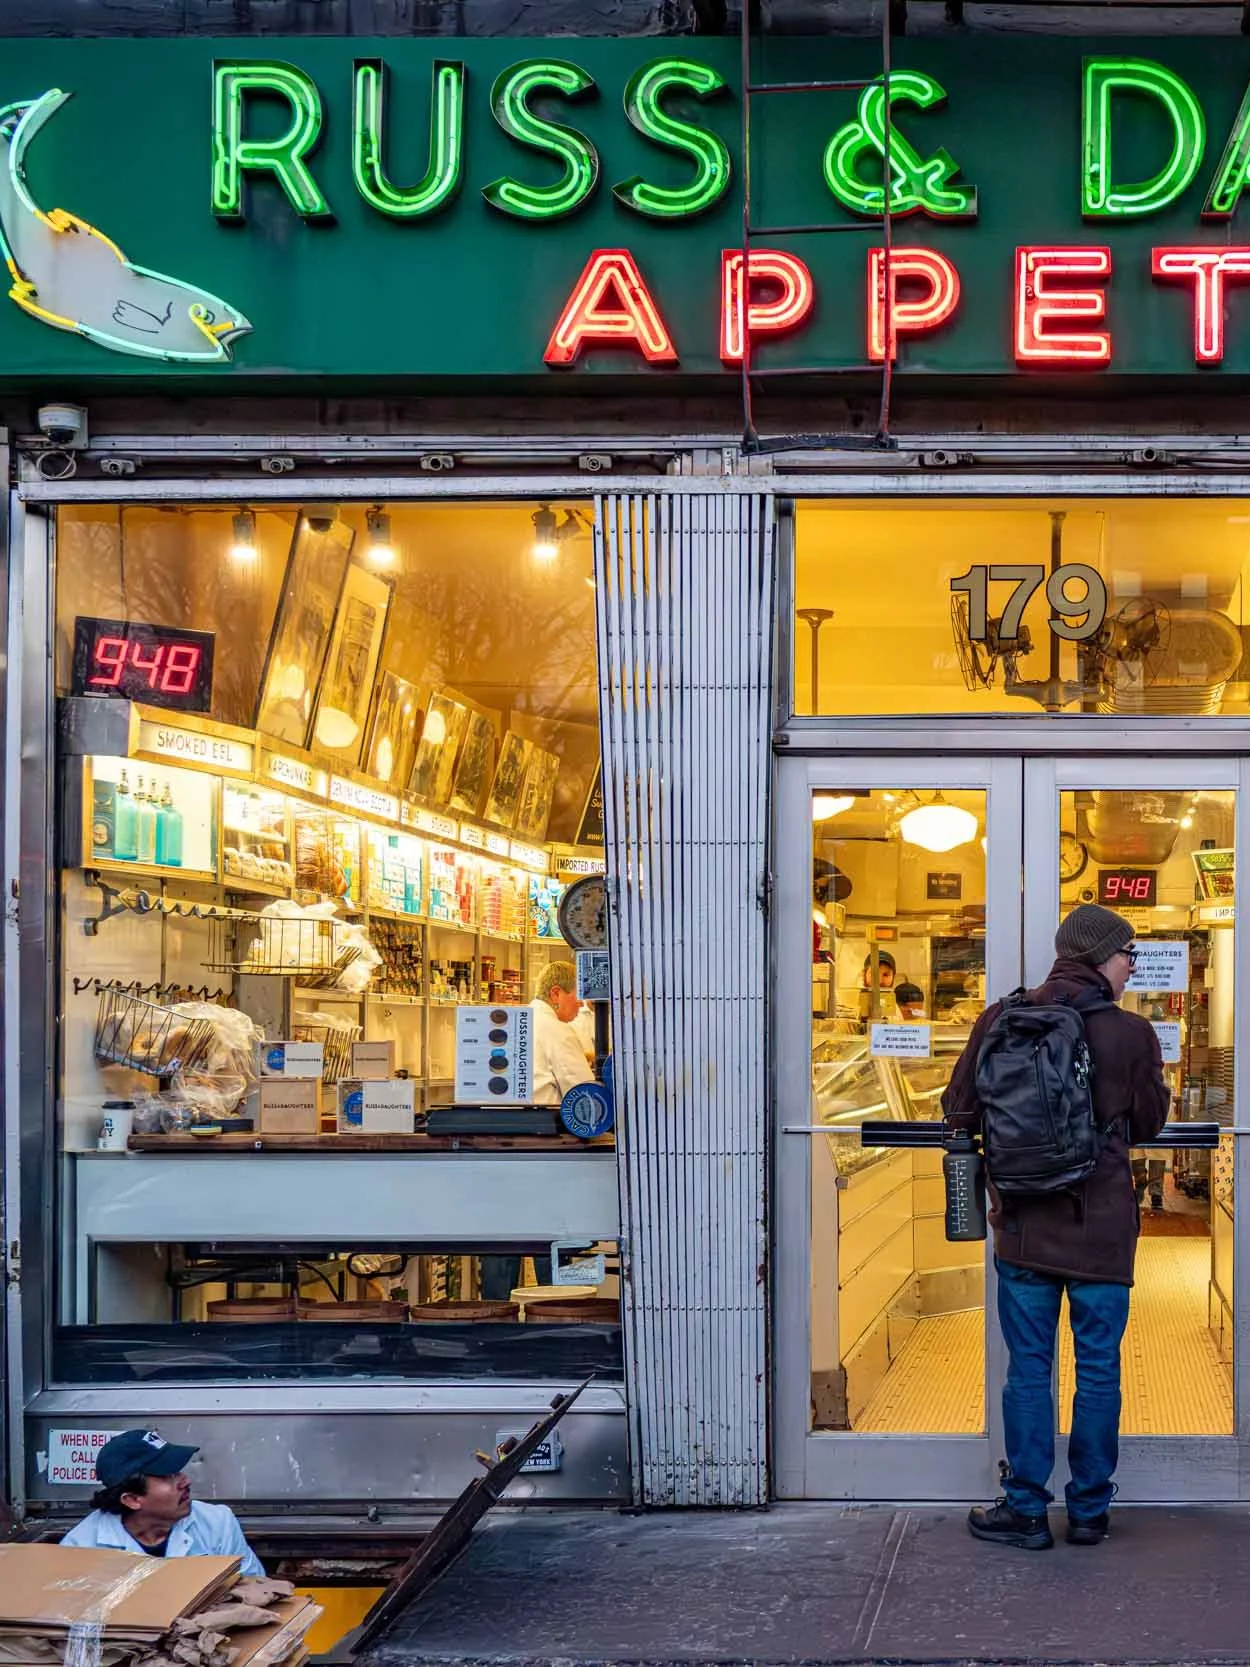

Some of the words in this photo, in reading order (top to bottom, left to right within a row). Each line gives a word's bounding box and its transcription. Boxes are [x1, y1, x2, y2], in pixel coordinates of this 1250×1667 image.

[211, 57, 731, 222] RUSS
[823, 69, 978, 219] &
[950, 563, 1107, 641] 179
[90, 638, 201, 693] 948
[157, 731, 207, 756] SMOKED
[212, 743, 233, 762] EEL
[556, 858, 589, 872] IMPORTED
[1104, 877, 1151, 898] 948
[561, 1089, 590, 1136] CAVIAR
[60, 1434, 89, 1446] WHEN
[91, 1434, 113, 1447] BEL
[71, 1452, 95, 1464] CALL
[53, 1468, 87, 1480] POLICE
